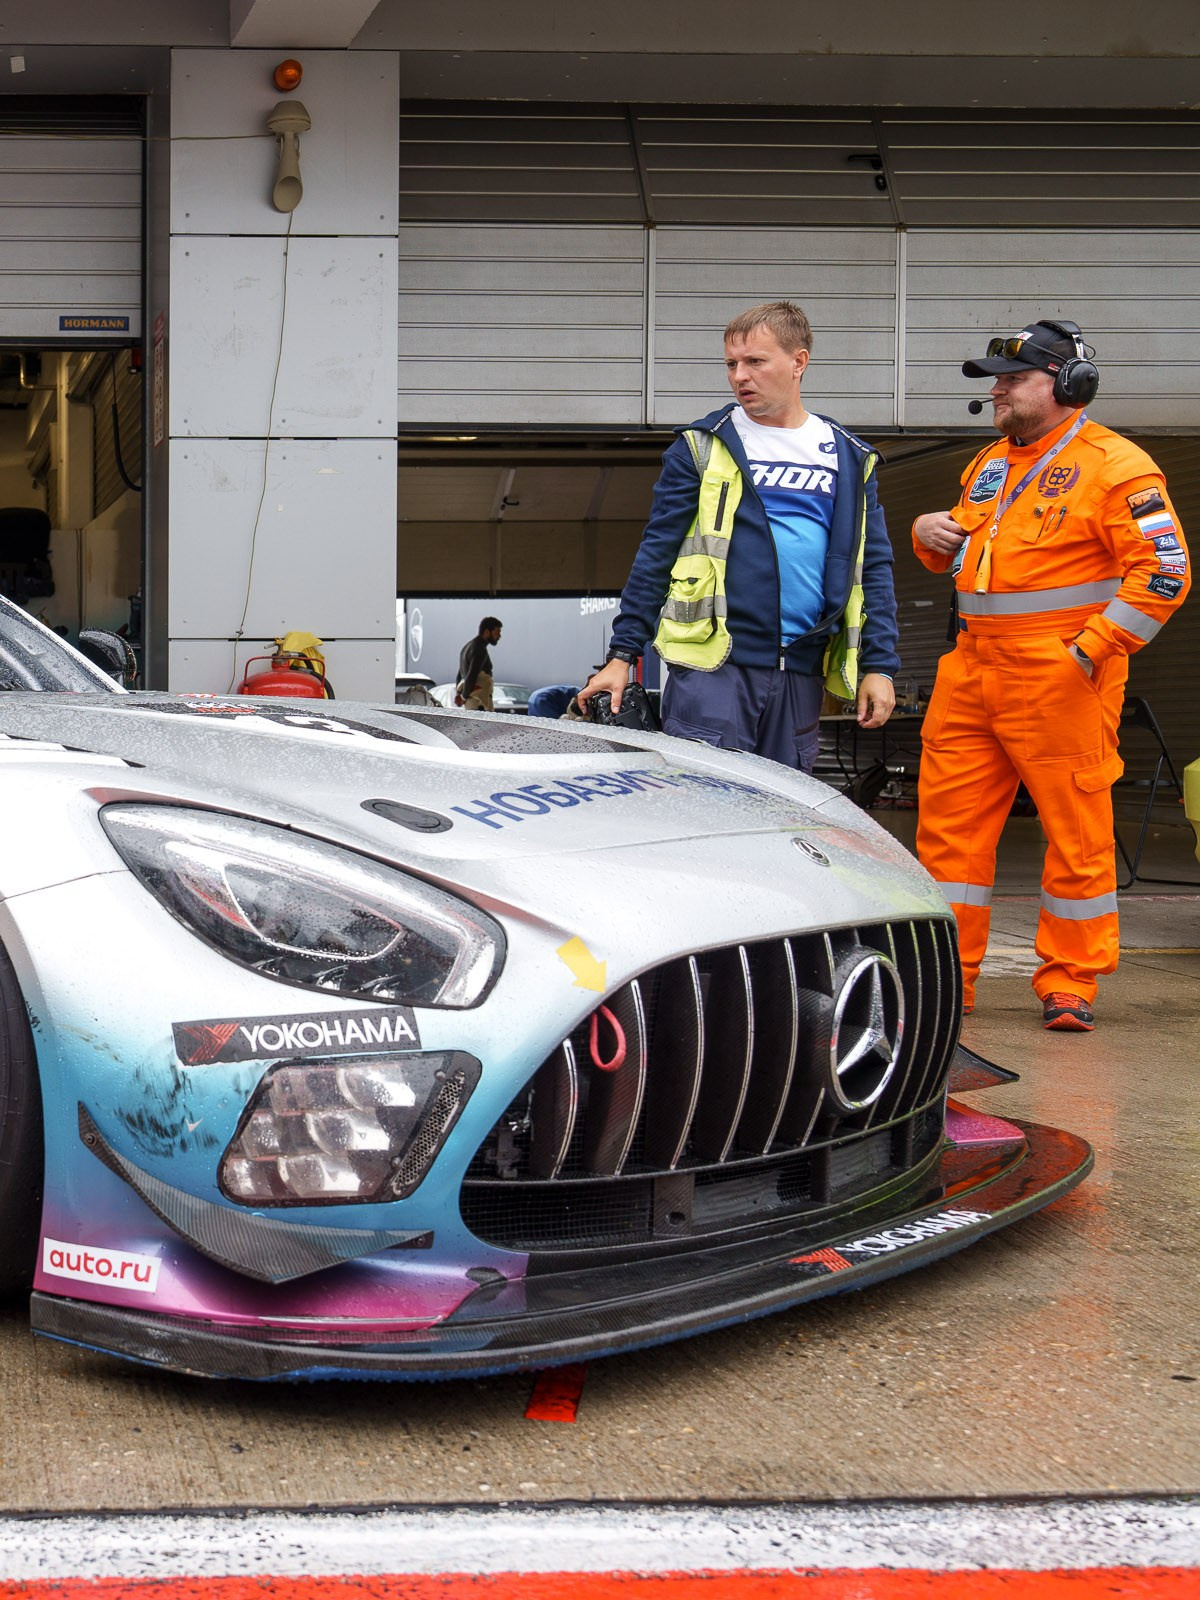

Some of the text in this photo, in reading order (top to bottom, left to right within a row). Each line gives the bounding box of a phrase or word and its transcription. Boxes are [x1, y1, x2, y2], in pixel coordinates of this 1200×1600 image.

[240, 1015, 417, 1053] YOKOHAMA
[835, 1209, 993, 1256] YOKOHAMA
[49, 1249, 152, 1283] auto.ru
